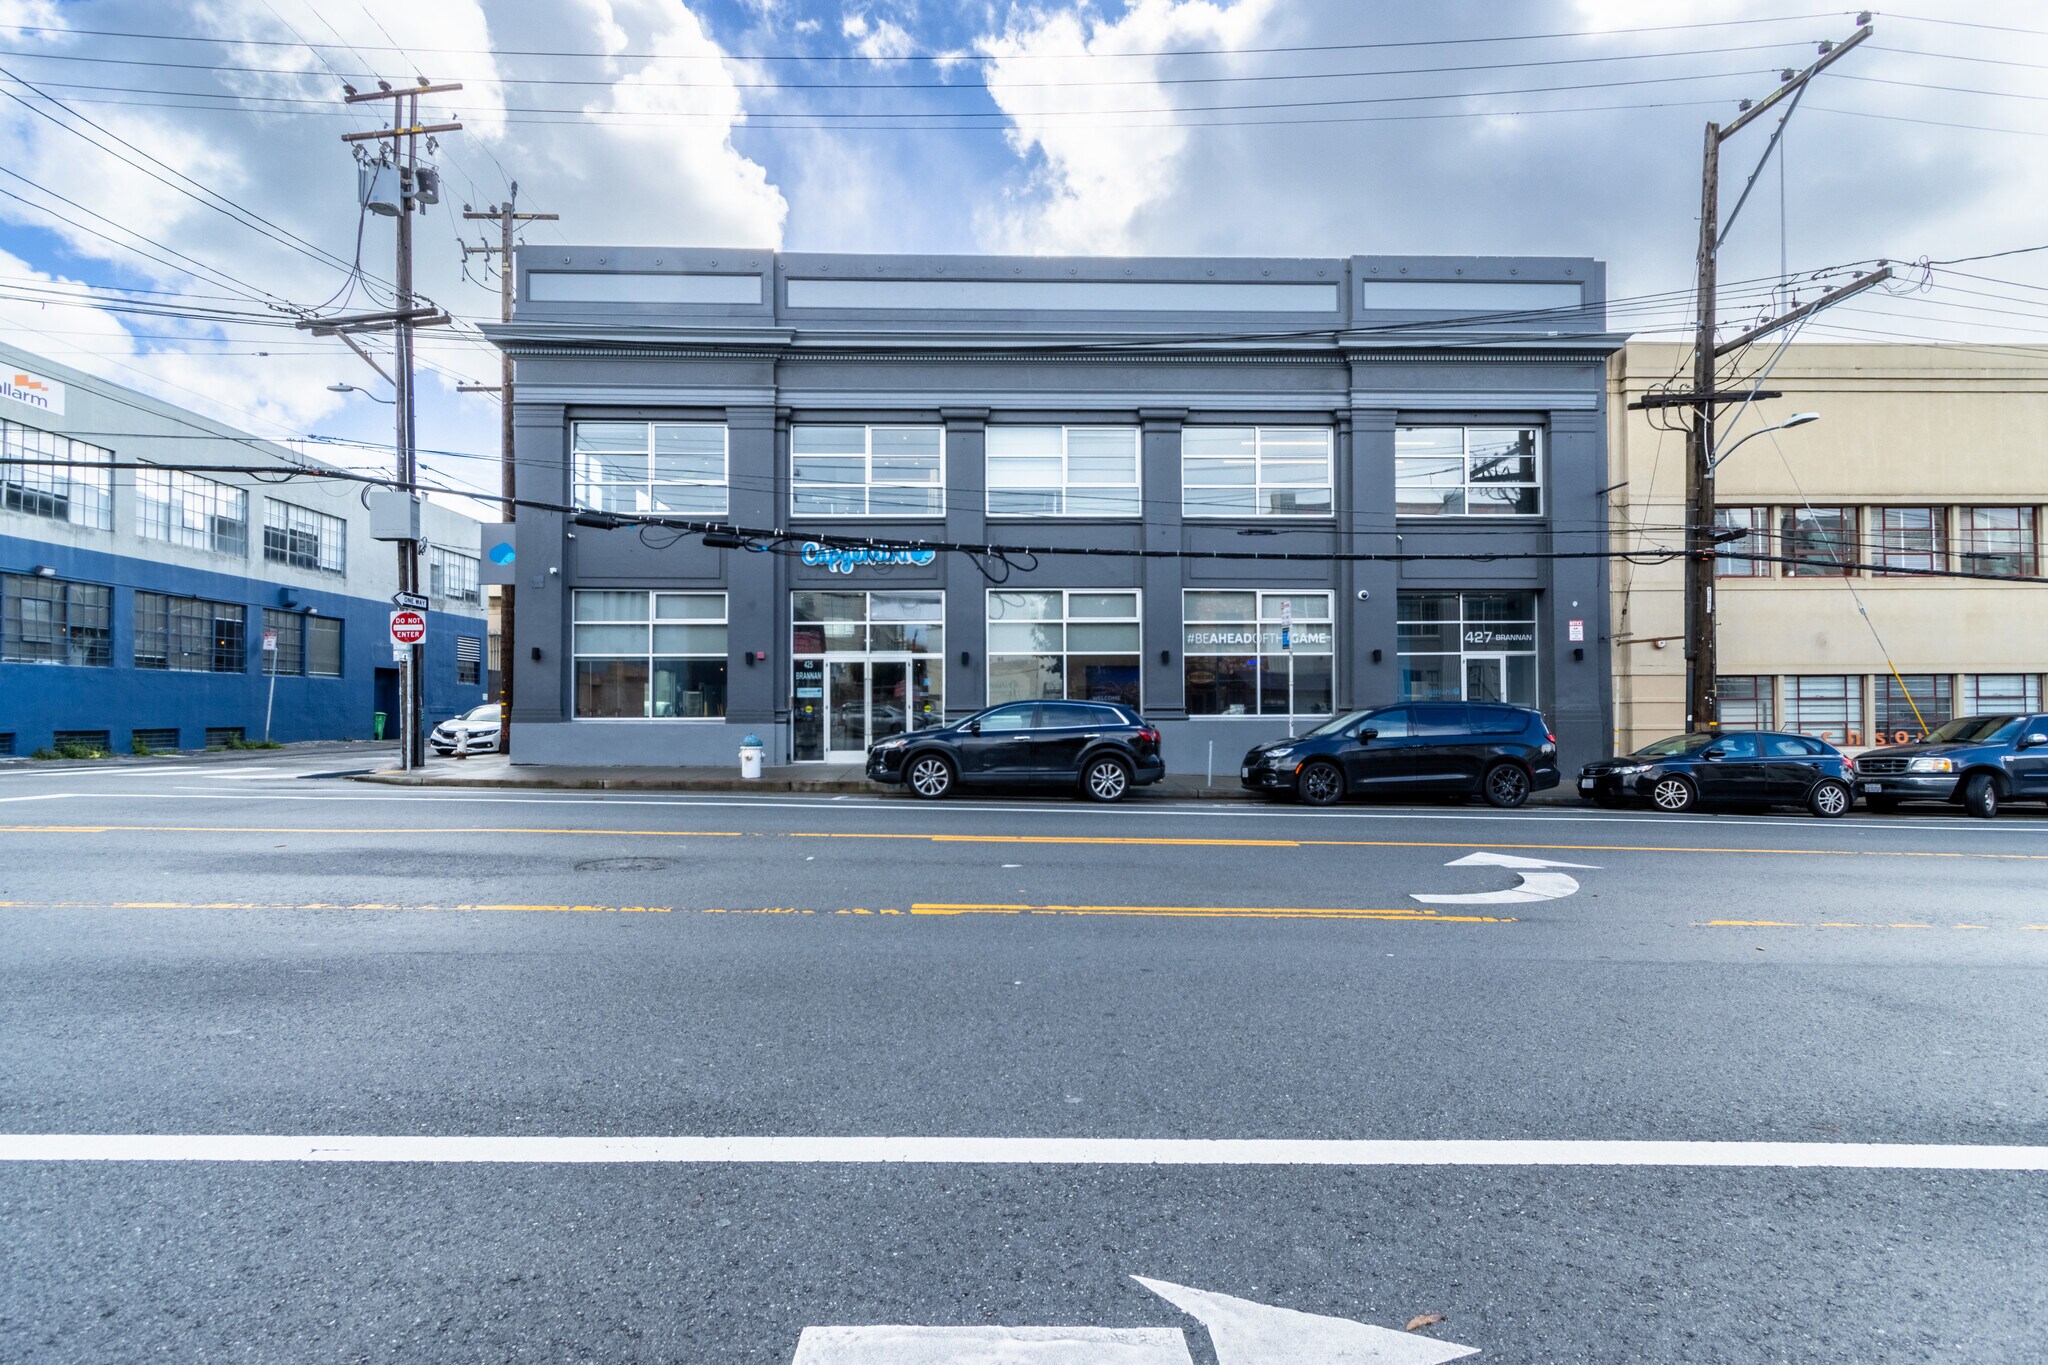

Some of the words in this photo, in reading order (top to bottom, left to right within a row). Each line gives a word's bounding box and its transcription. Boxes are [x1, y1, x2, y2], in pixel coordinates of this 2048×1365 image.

[0, 382, 48, 408] llarm
[1186, 632, 1327, 644] #BEAHEADOFTHGAME
[1464, 631, 1493, 644] 427
[1495, 634, 1533, 642] BRANNAN
[803, 660, 814, 669] 425
[795, 671, 822, 680] BRANNAN
